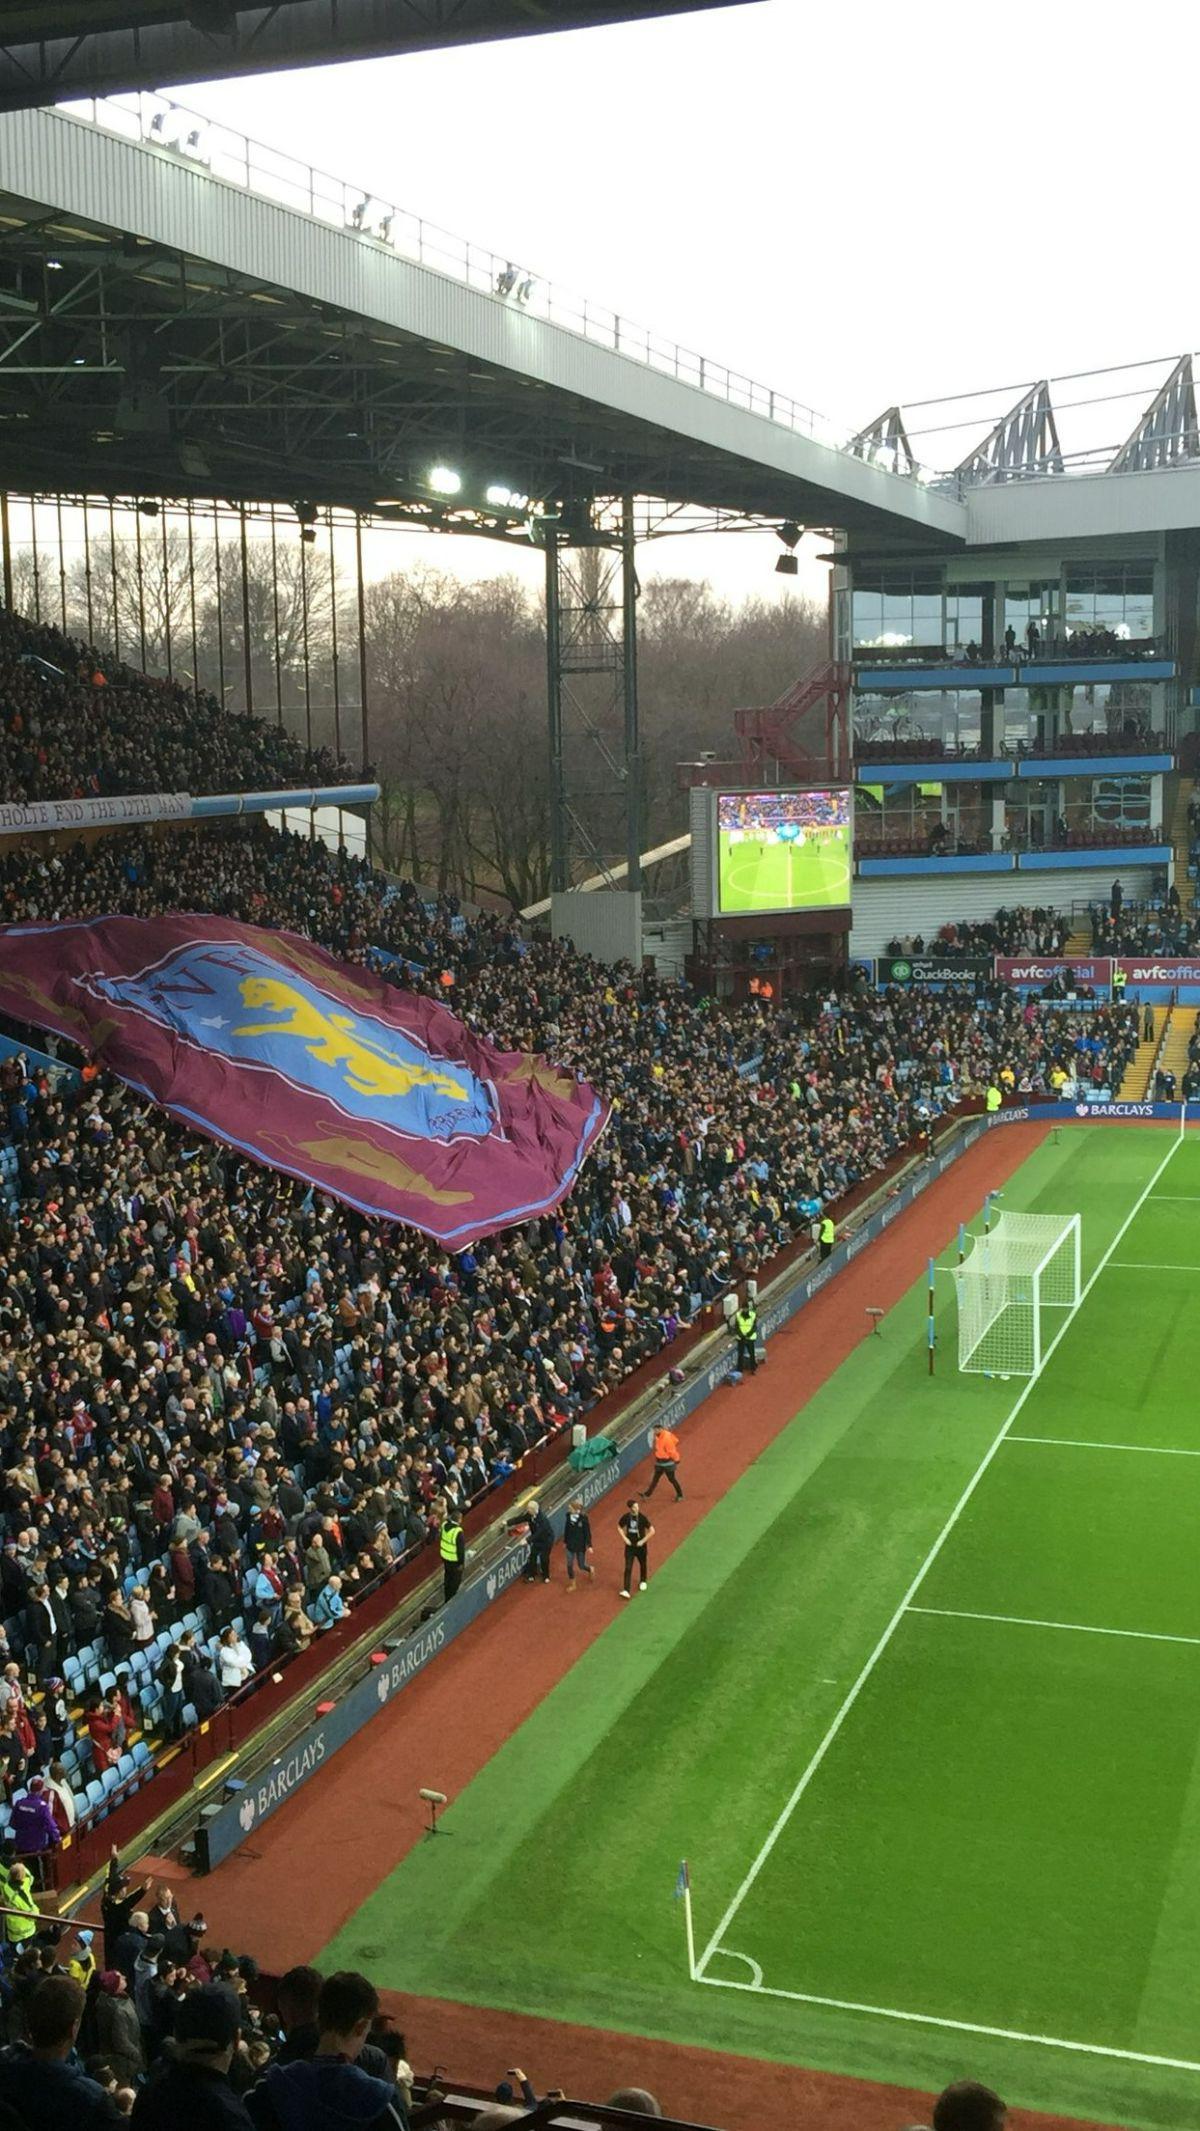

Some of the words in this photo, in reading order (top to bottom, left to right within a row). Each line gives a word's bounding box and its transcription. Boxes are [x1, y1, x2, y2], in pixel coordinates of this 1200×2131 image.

[2, 805, 49, 827] HOLTE
[54, 803, 84, 822] END
[88, 801, 117, 819] THE
[122, 799, 151, 817] 12TH
[1091, 1104, 1154, 1116] BARCLAYS
[392, 1621, 445, 1688] BARCLAYS
[258, 1732, 325, 1816] BARCLAYS
